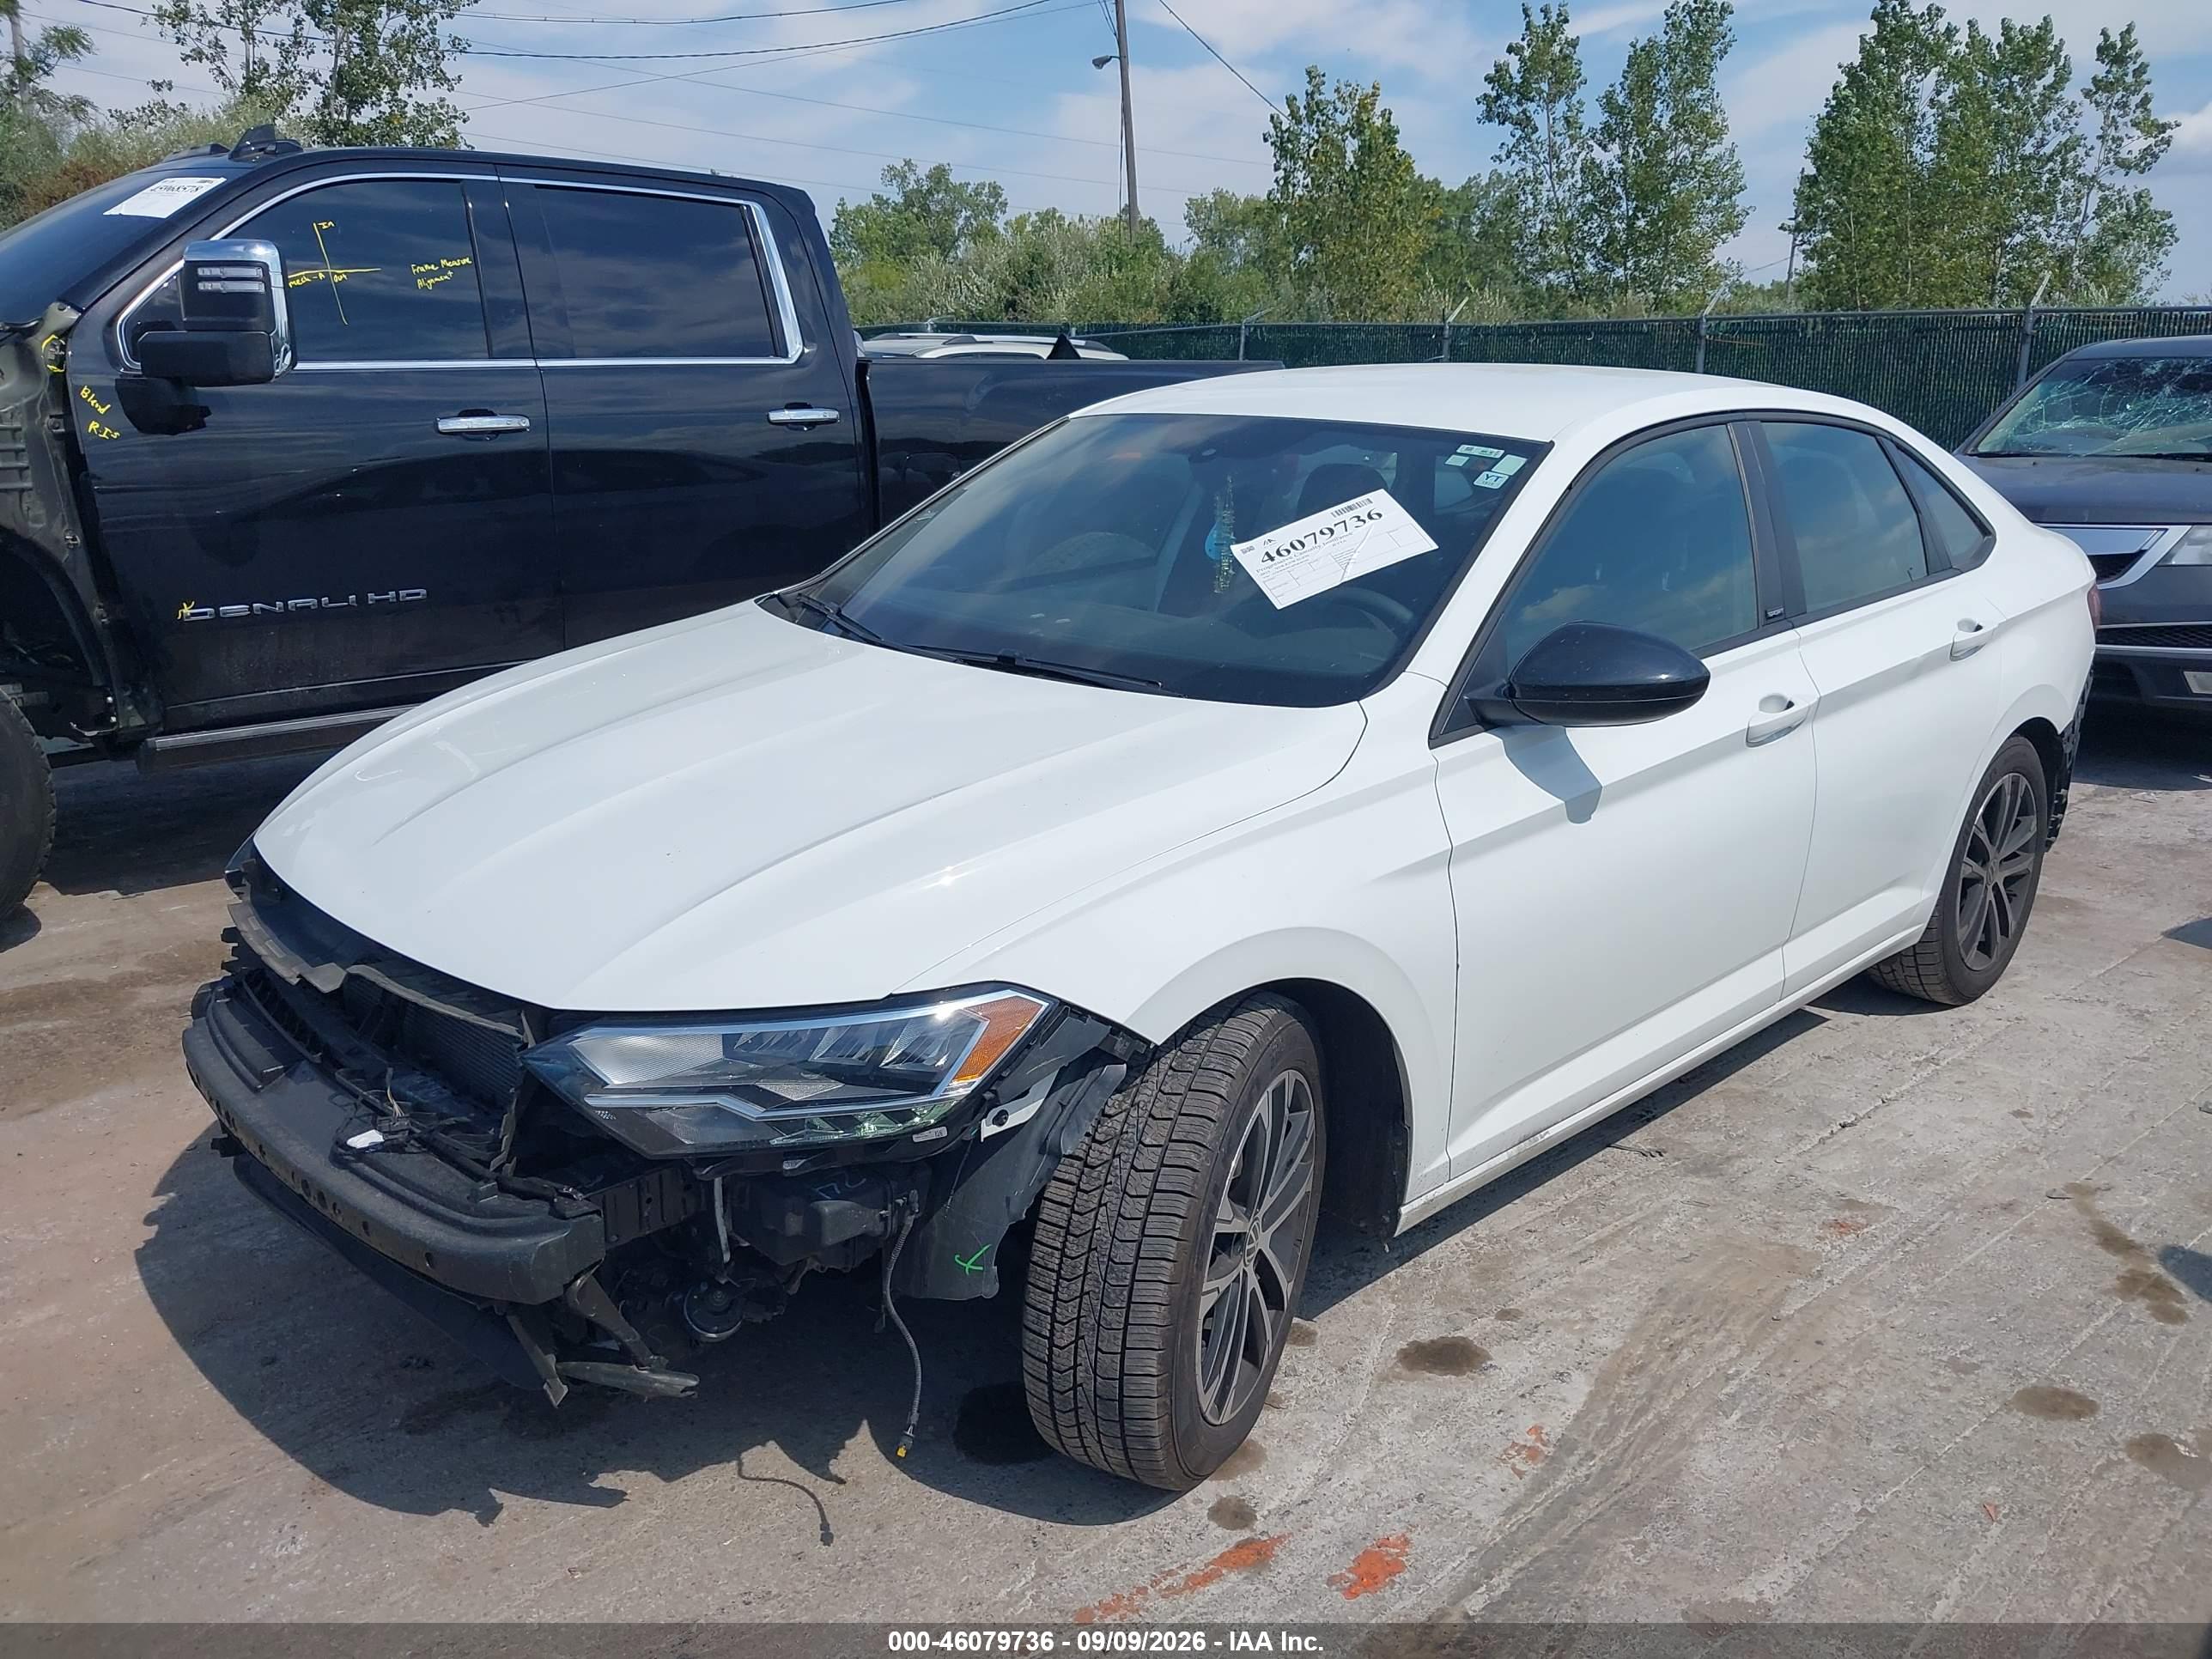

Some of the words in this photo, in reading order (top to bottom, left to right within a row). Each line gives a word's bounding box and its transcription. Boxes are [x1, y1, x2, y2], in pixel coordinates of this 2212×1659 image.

[80, 385, 111, 414] Blend
[1261, 507, 1383, 565] 46079736
[183, 594, 357, 622] DENALI
[368, 588, 428, 605] HD
